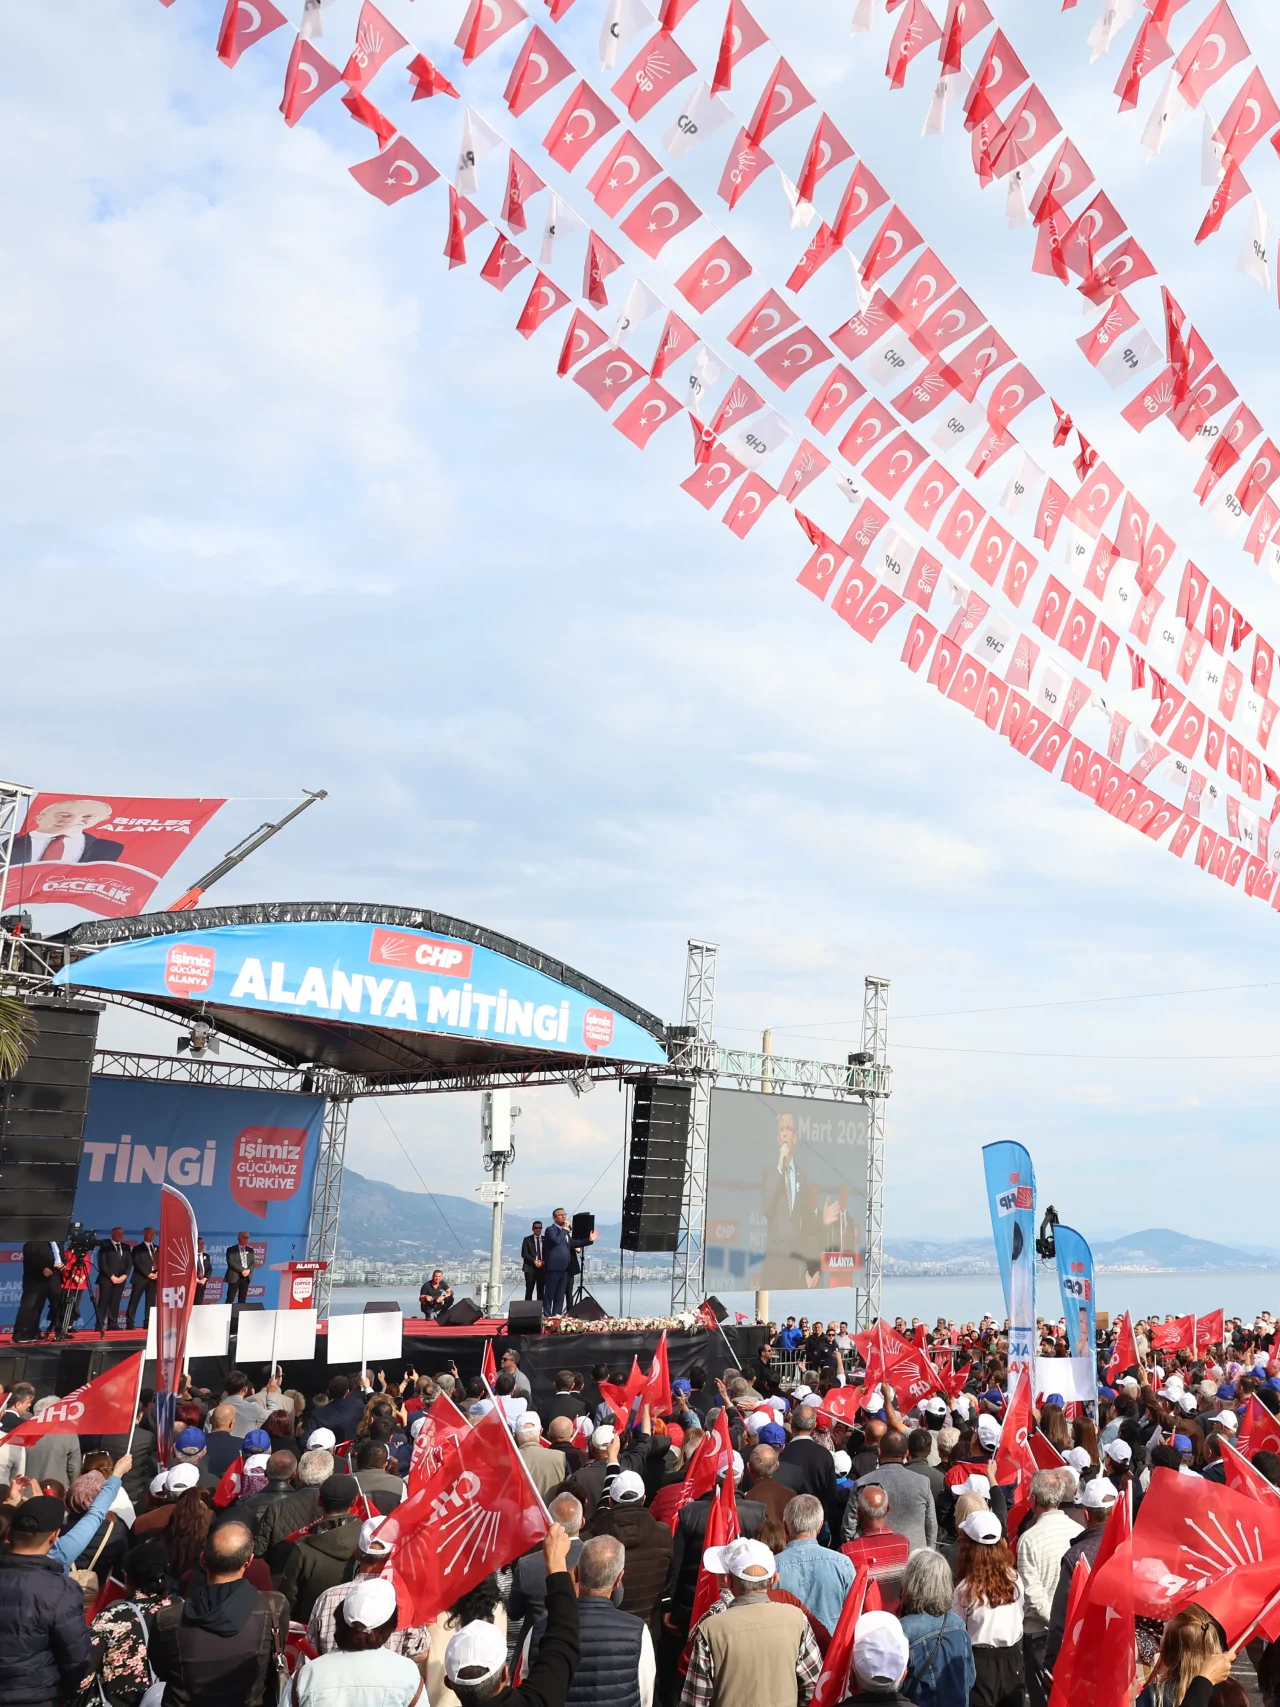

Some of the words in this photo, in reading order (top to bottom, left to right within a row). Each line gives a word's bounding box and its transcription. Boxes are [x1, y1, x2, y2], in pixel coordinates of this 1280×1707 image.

[848, 317, 868, 337] CHP
[884, 349, 905, 369] CHP
[912, 385, 931, 403] CHP
[947, 417, 965, 434] CHP
[855, 530, 871, 547] CHP
[917, 579, 932, 594] CHP
[96, 824, 191, 835] ALANYA
[171, 949, 211, 968] işimiz
[415, 943, 463, 969] CHP
[170, 964, 210, 977] GÜCÜMÜZ
[168, 974, 208, 987] ALANYA
[229, 957, 418, 1021] ALANYA
[426, 982, 570, 1043] MİTİNGİ
[799, 1115, 833, 1143] Mart
[239, 1136, 301, 1160] işimiz
[237, 1159, 298, 1175] GÜCÜMÜZ
[237, 1174, 295, 1190] TÜRKİYE
[716, 1225, 735, 1239] CHP
[829, 1256, 854, 1268] ALANYA
[248, 1287, 263, 1296] CHP
